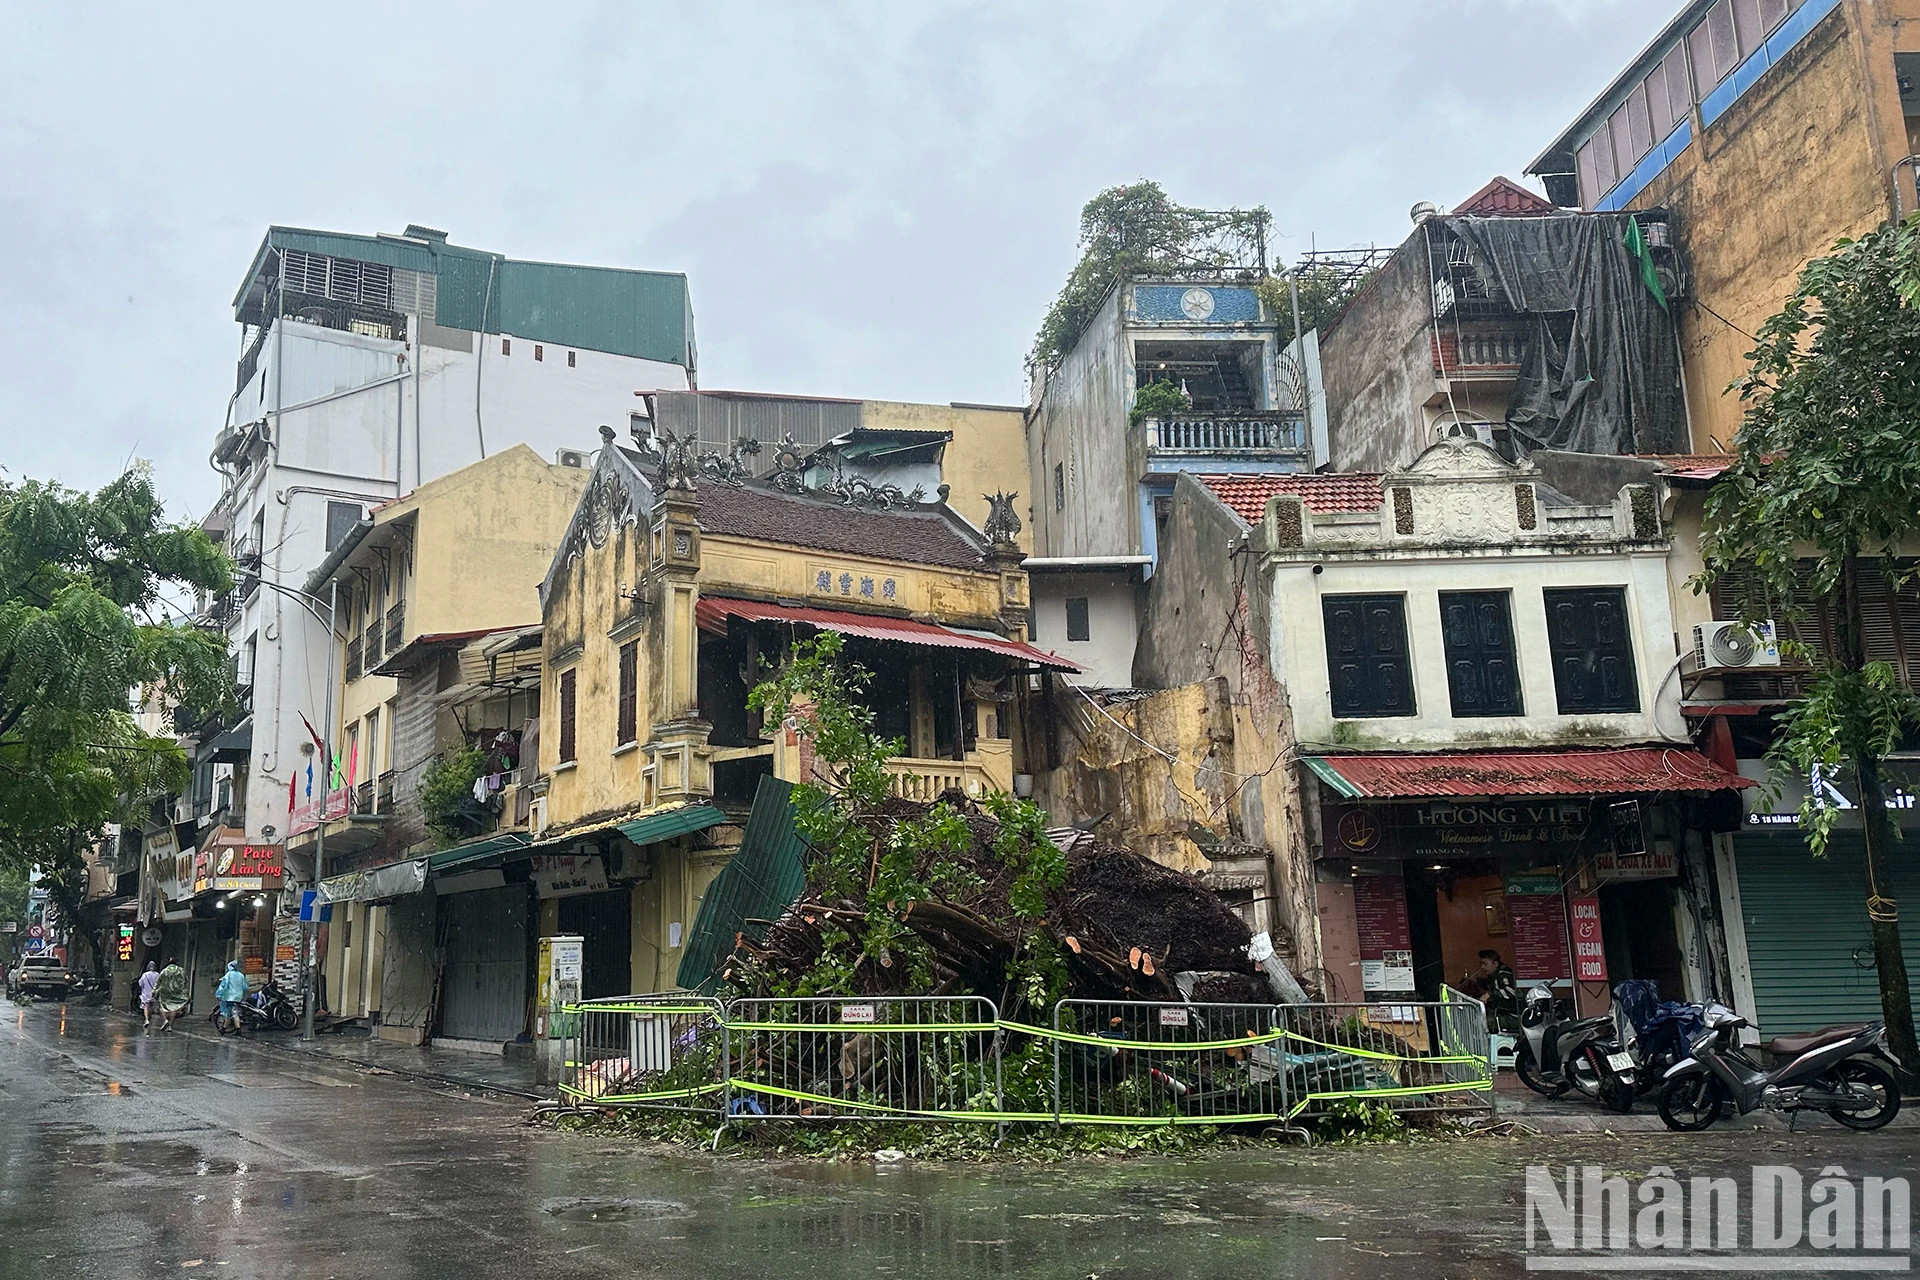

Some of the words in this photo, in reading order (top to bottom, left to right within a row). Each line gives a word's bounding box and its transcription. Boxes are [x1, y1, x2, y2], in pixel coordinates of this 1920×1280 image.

[1418, 805, 1516, 826] HƯƠNG
[1438, 829, 1494, 845] Vietnamese
[1500, 826, 1532, 843] Drink
[1536, 826, 1549, 841] &
[1553, 825, 1586, 843] Food
[243, 846, 274, 859] Pate
[1641, 855, 1652, 869] XE
[1654, 851, 1673, 868] MÁY
[231, 862, 254, 875] Lãn
[258, 860, 282, 878] Ông
[1574, 904, 1597, 919] LOCAL
[1579, 922, 1594, 938] &
[1577, 942, 1602, 956] VEGAN
[1582, 961, 1601, 976] FOOD
